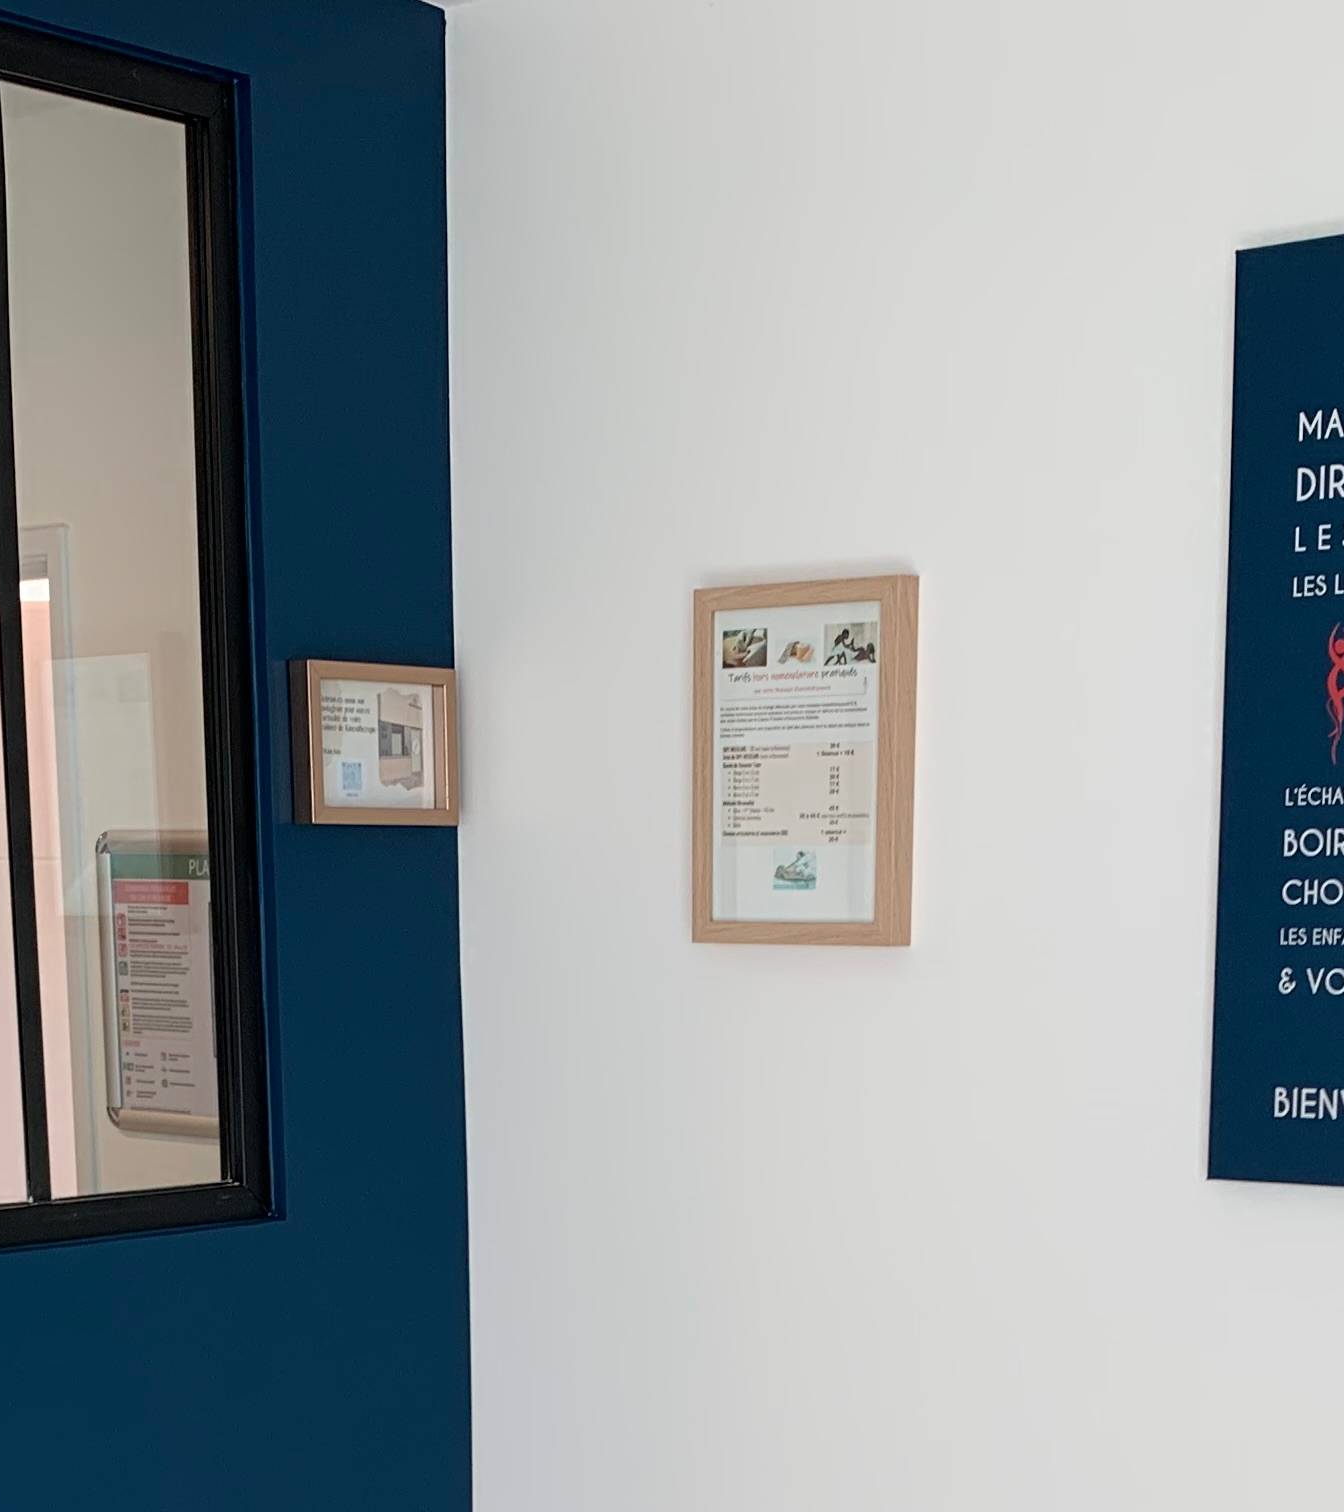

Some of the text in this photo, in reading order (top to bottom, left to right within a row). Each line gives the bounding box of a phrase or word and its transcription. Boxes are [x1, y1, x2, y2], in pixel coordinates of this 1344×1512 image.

[1292, 574, 1327, 598] LES
[1280, 927, 1307, 946] LES
[1278, 967, 1297, 995] &
